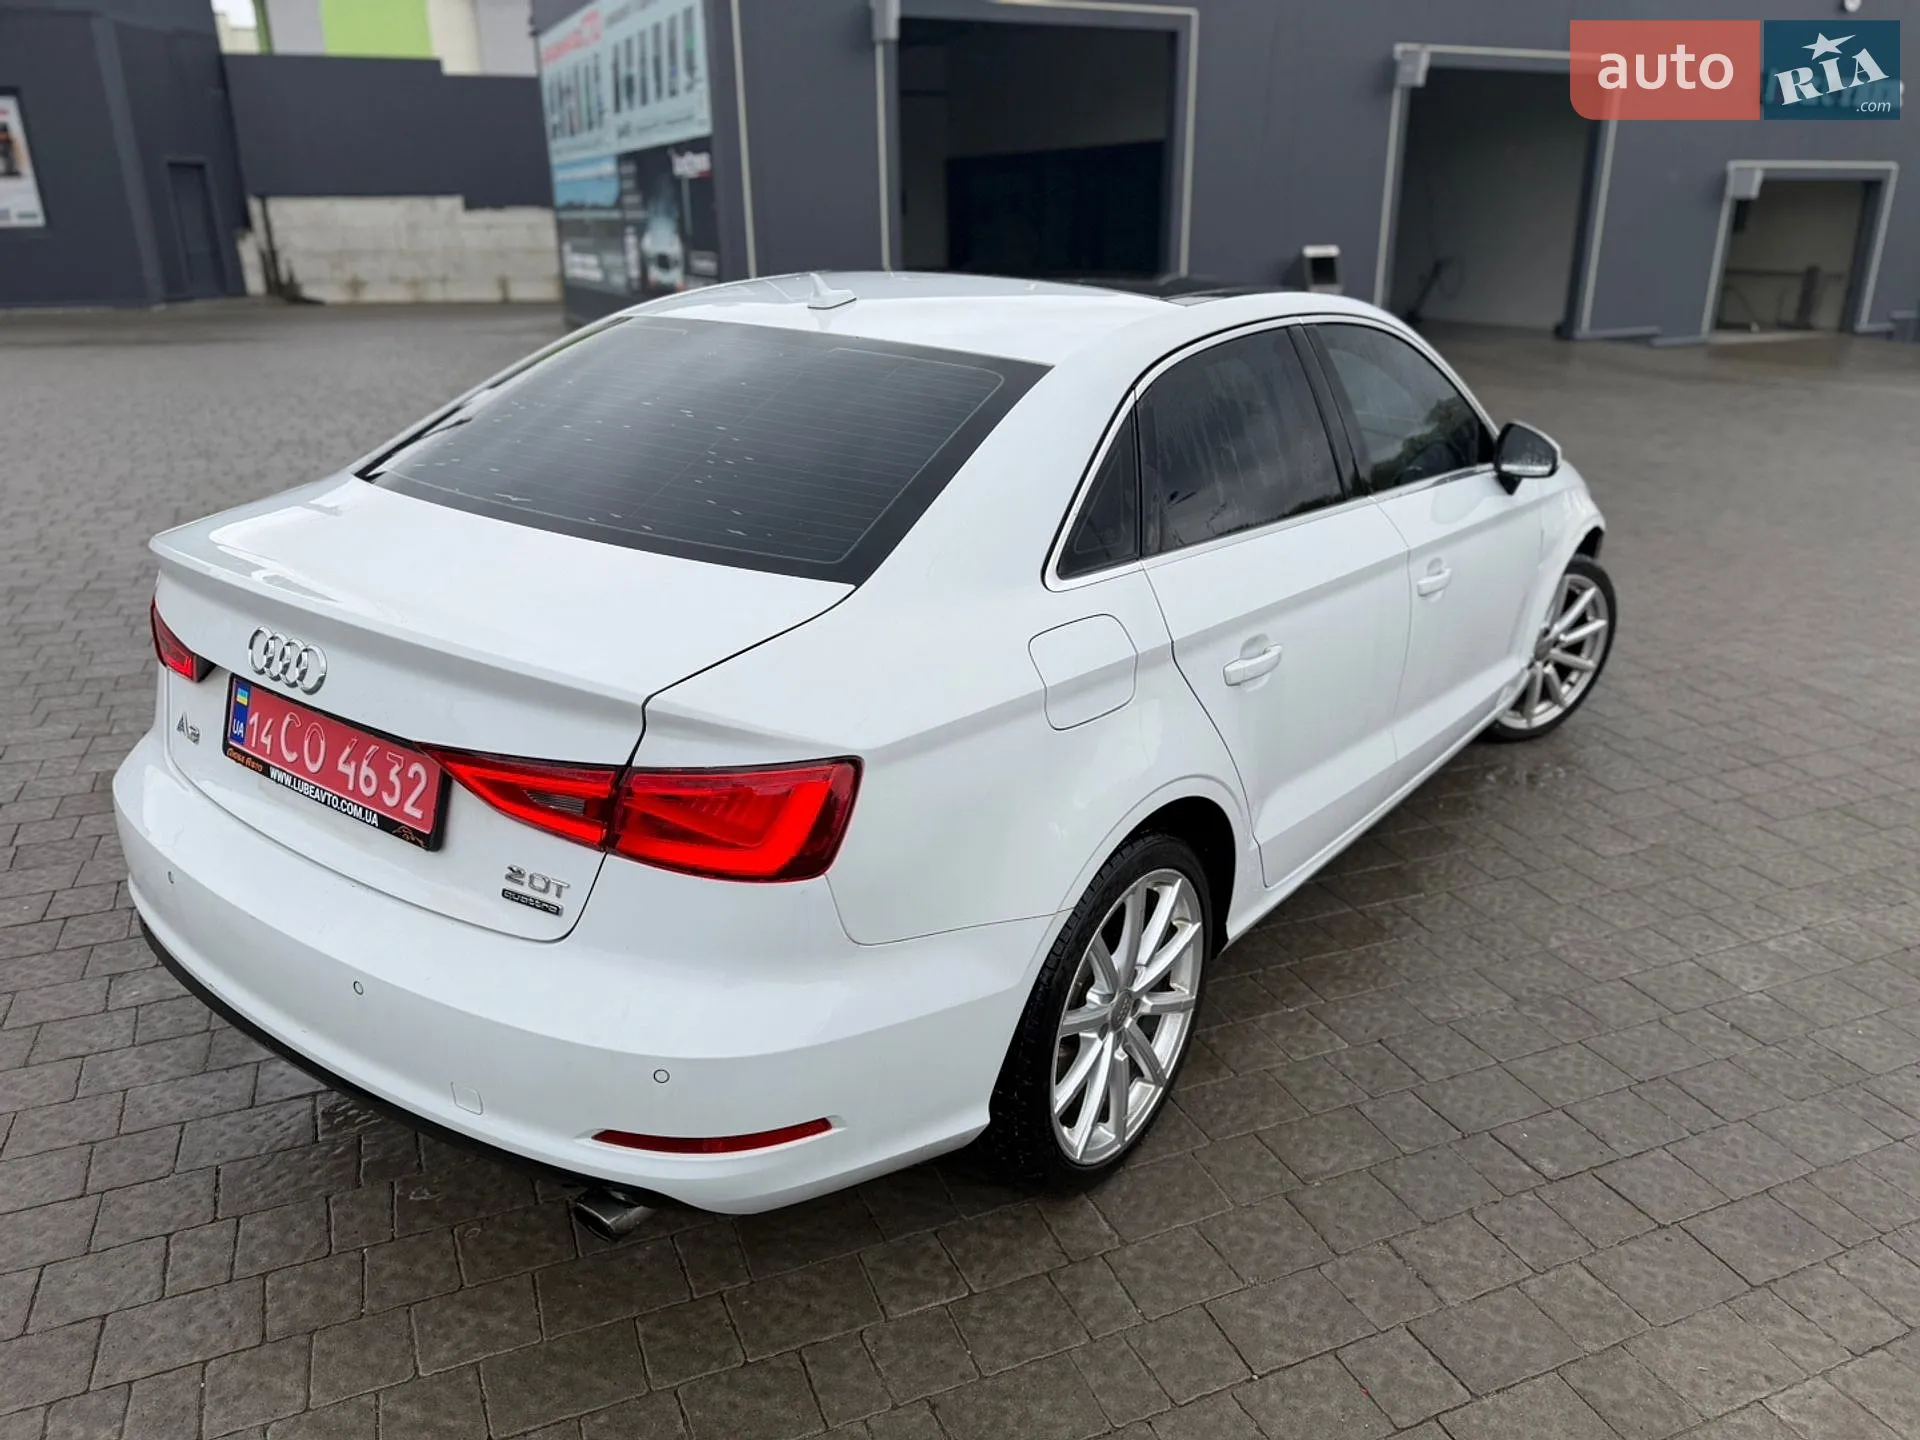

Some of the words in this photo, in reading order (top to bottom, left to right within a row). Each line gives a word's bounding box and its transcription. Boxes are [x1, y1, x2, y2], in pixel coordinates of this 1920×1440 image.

[232, 718, 245, 737] UA
[269, 766, 379, 828] WWW.LUBEAVTO.COM.UA
[337, 737, 428, 820] 4632
